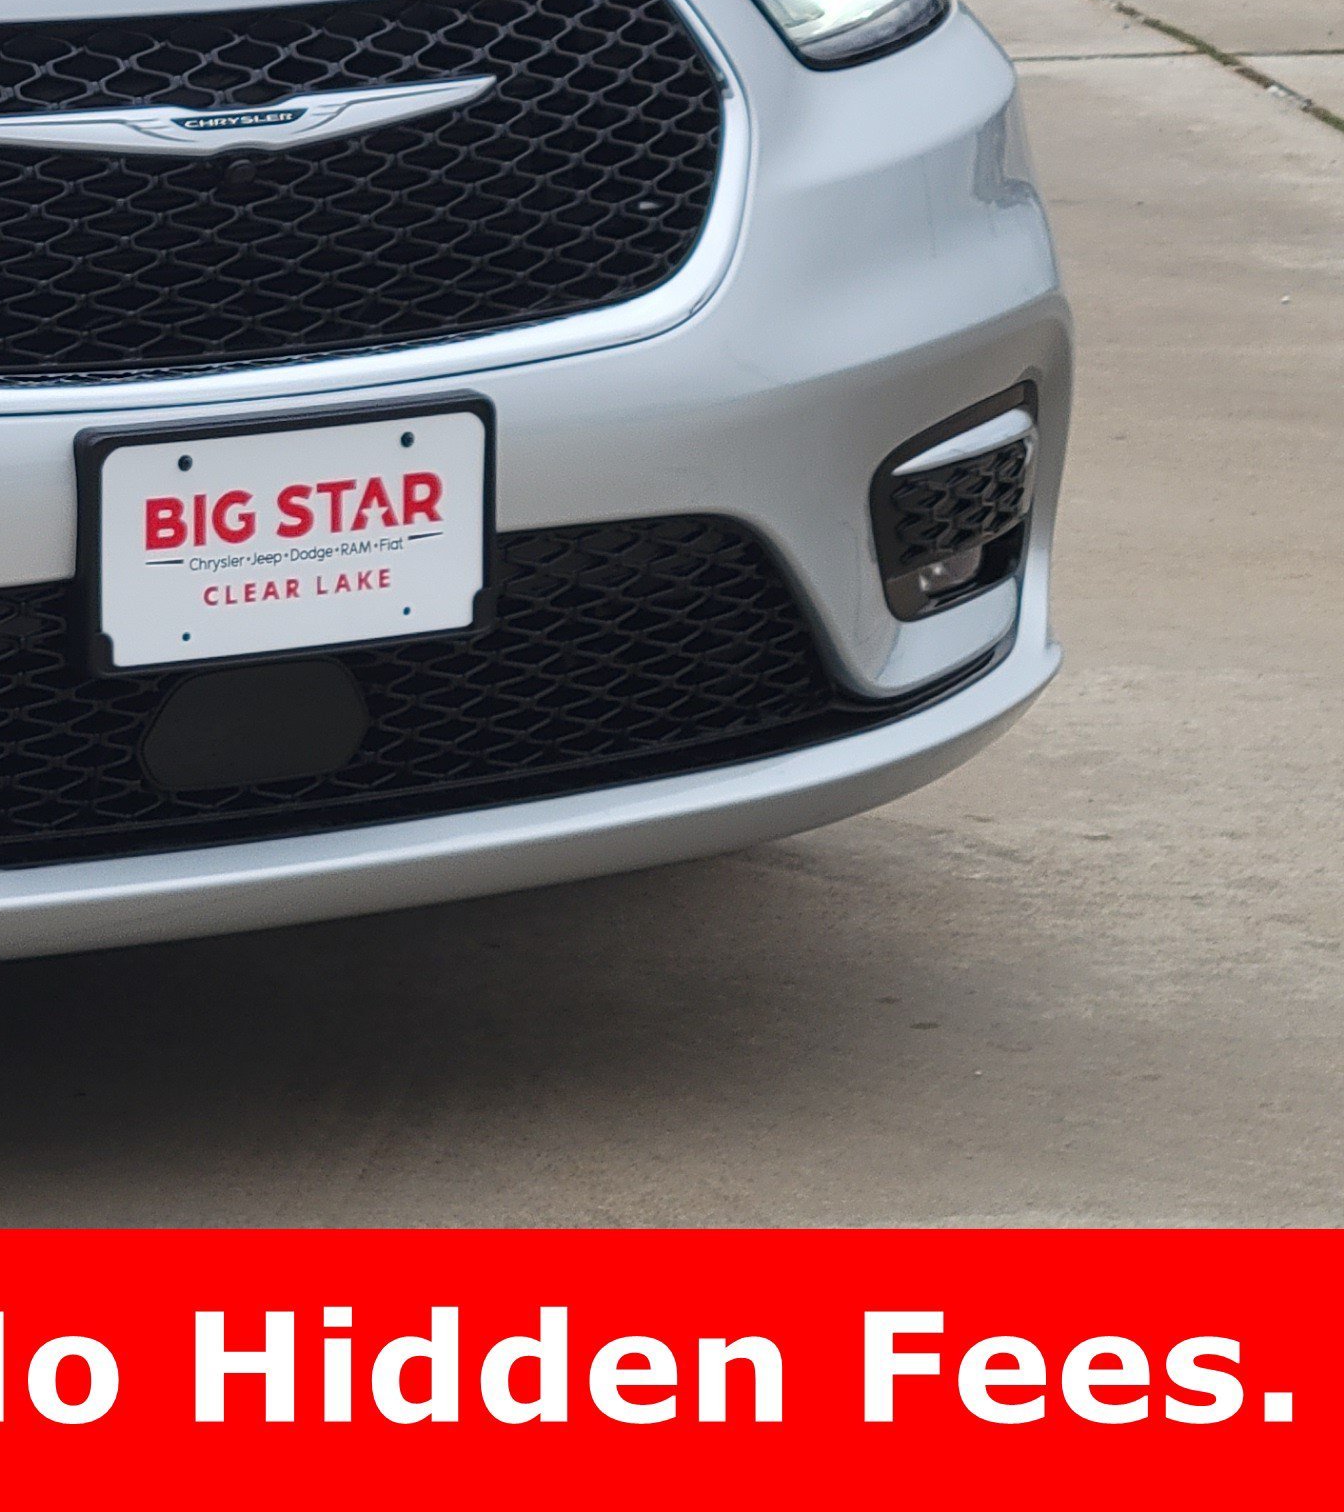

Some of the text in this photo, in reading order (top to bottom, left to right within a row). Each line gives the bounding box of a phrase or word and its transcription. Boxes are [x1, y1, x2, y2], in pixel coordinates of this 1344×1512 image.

[184, 113, 294, 129] CHRYSLER
[144, 472, 443, 551] BIG STAR
[189, 537, 404, 573] Chrysler Jeep Dodge RAM Fiat
[203, 568, 392, 606] CLEAR LAKE
